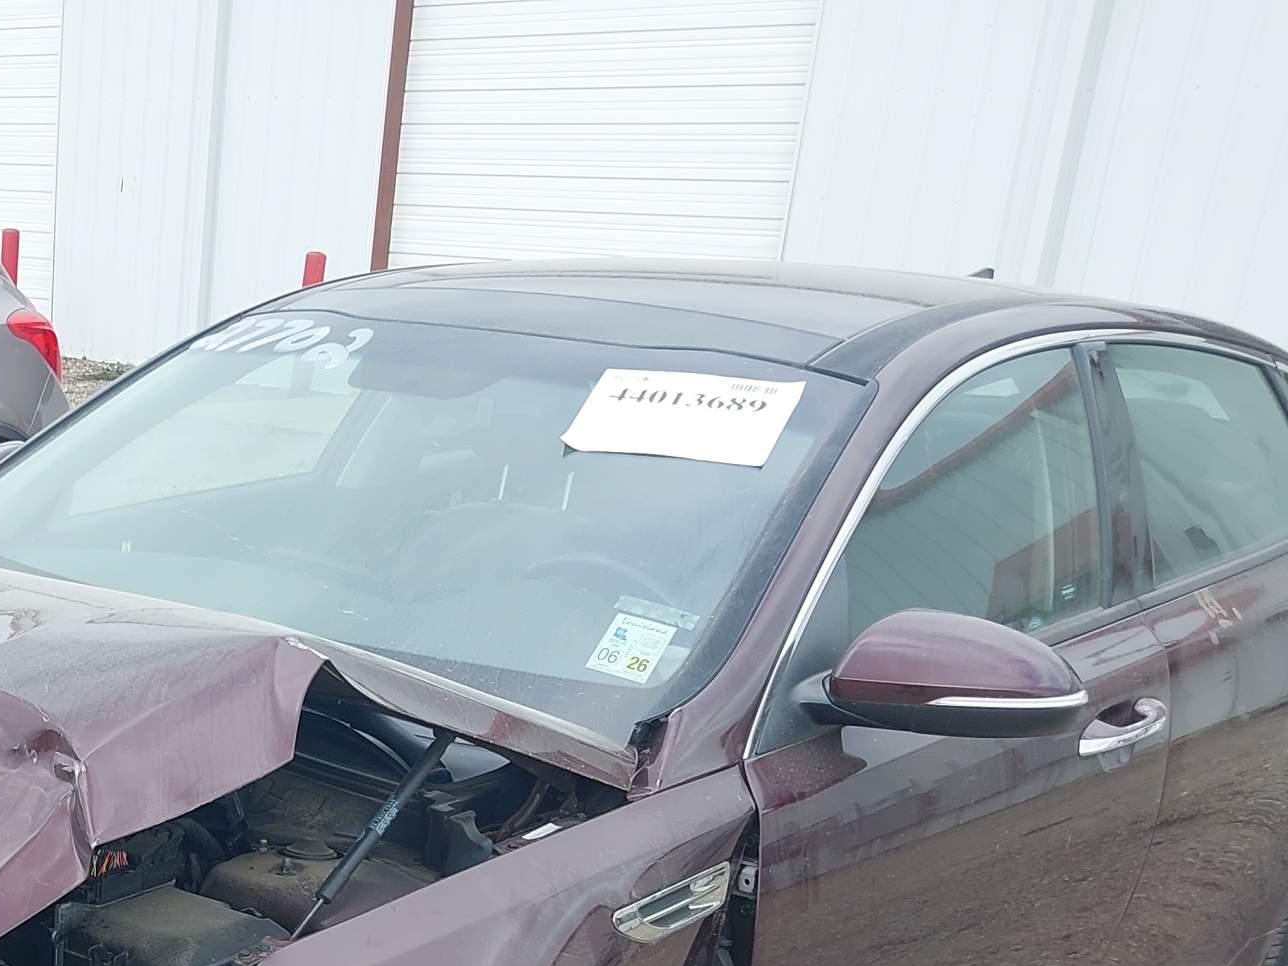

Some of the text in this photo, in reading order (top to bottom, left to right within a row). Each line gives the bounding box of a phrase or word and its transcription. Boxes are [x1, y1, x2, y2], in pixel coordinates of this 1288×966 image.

[609, 387, 767, 413] 44013689
[597, 647, 620, 664] 06
[626, 656, 650, 673] 26
